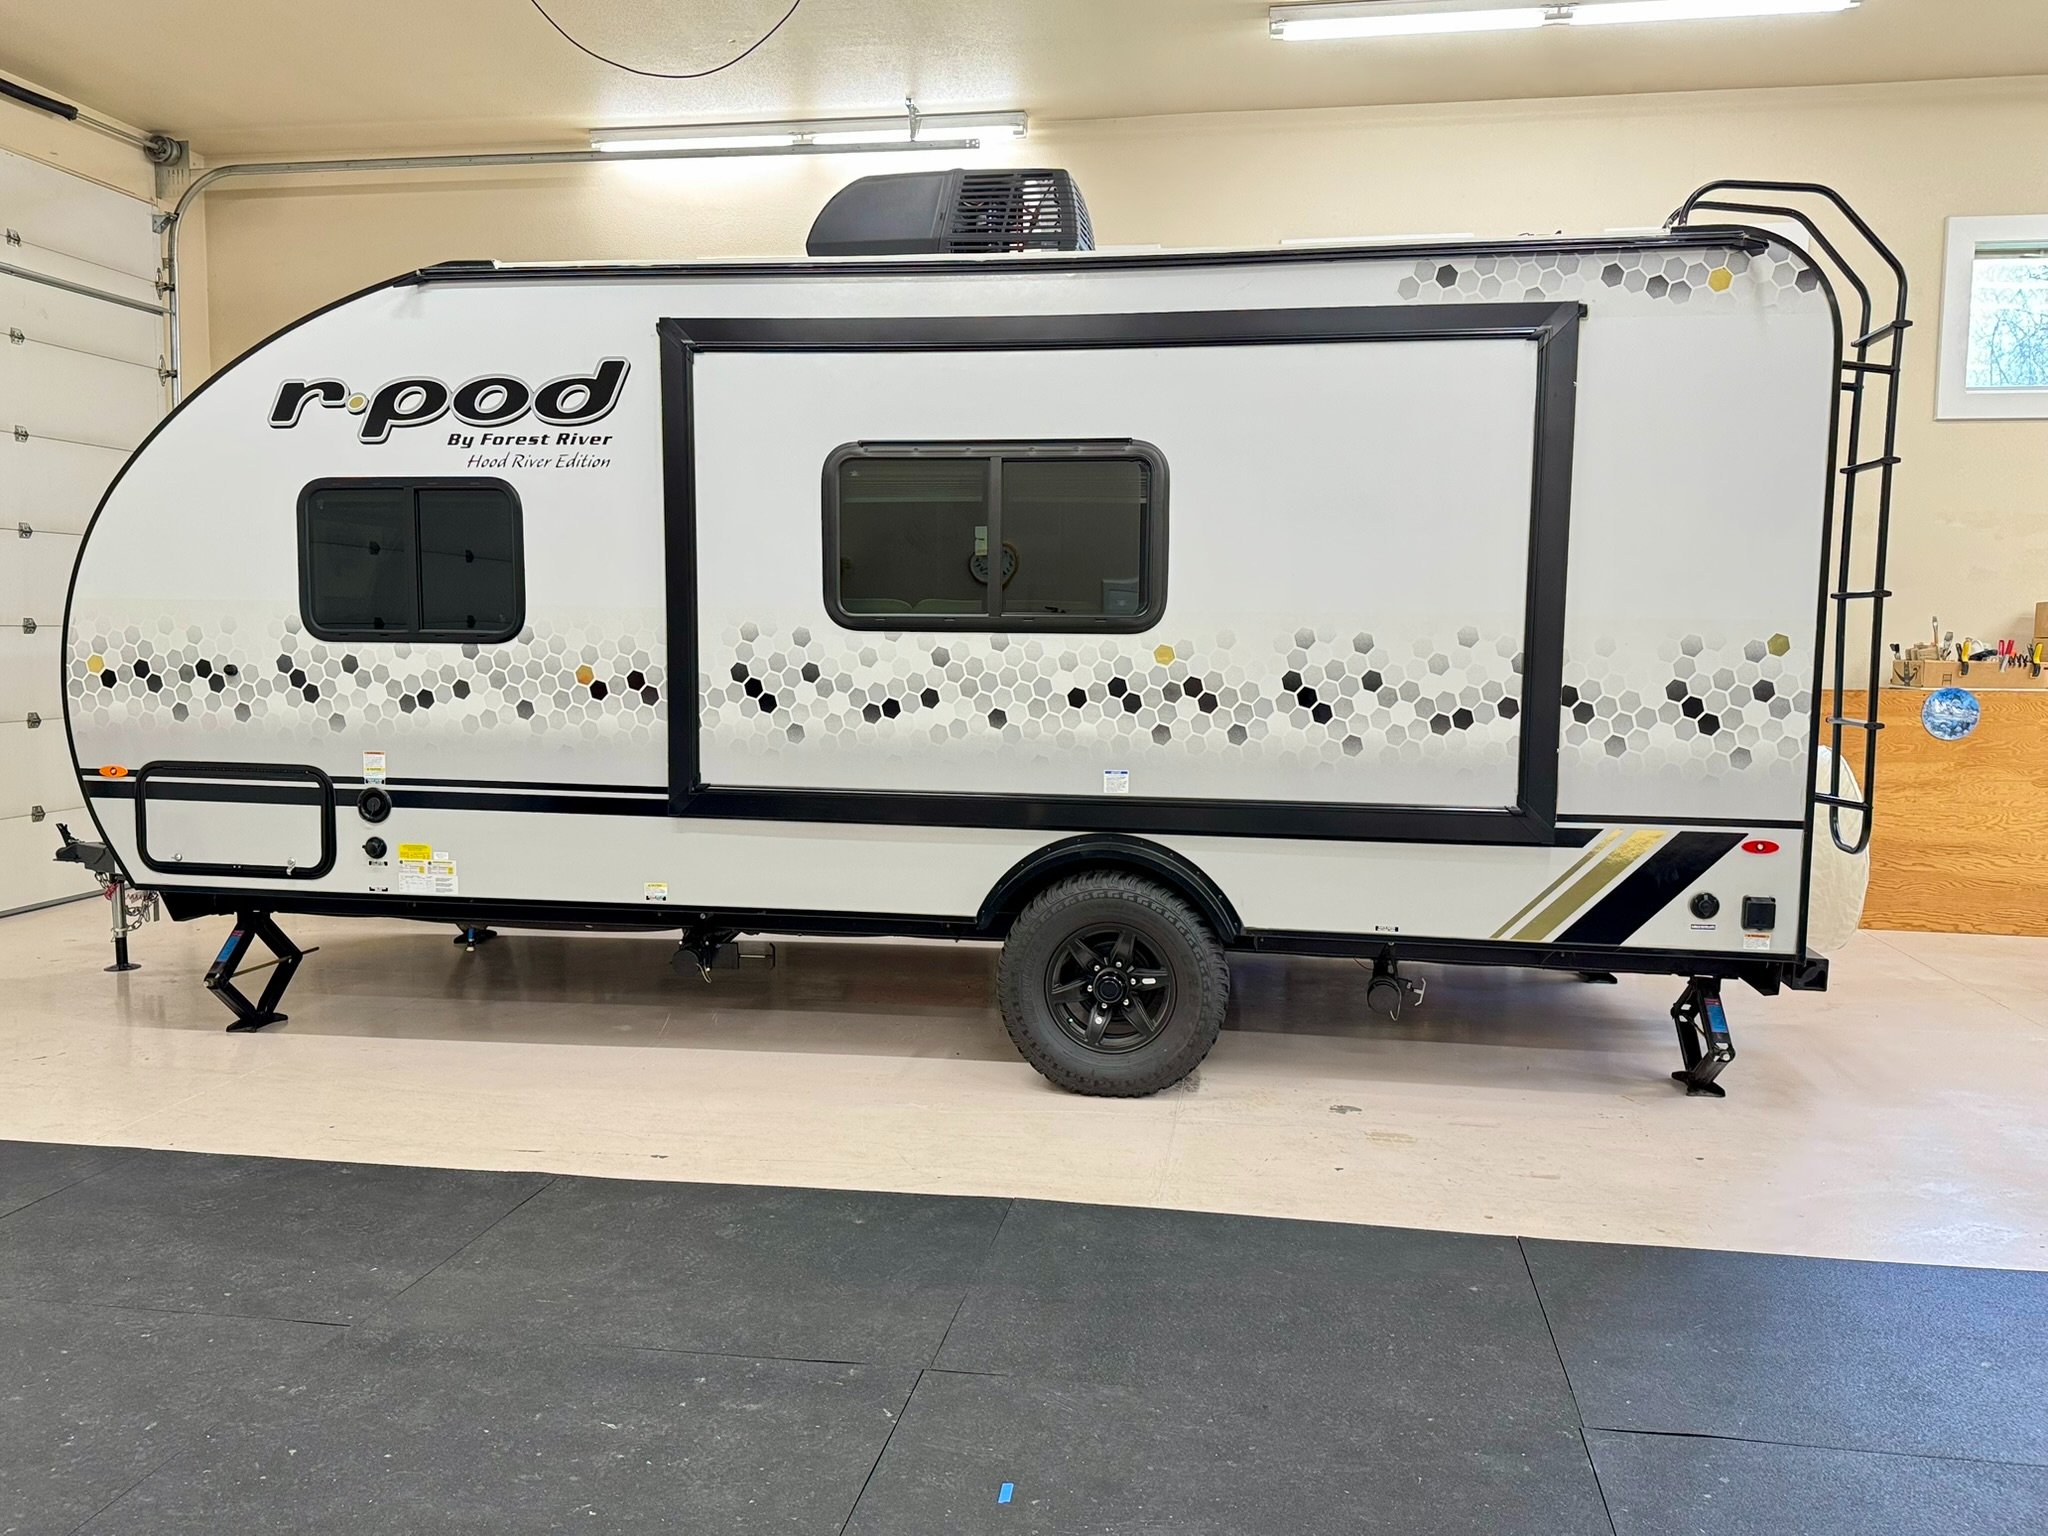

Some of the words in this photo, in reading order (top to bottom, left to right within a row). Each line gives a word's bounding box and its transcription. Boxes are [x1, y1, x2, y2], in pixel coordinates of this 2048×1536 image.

[447, 433, 474, 448] By
[480, 433, 549, 446] Forest
[556, 432, 612, 446] River
[467, 451, 510, 468] Hood
[511, 453, 552, 468] River
[555, 451, 611, 468] Edition
